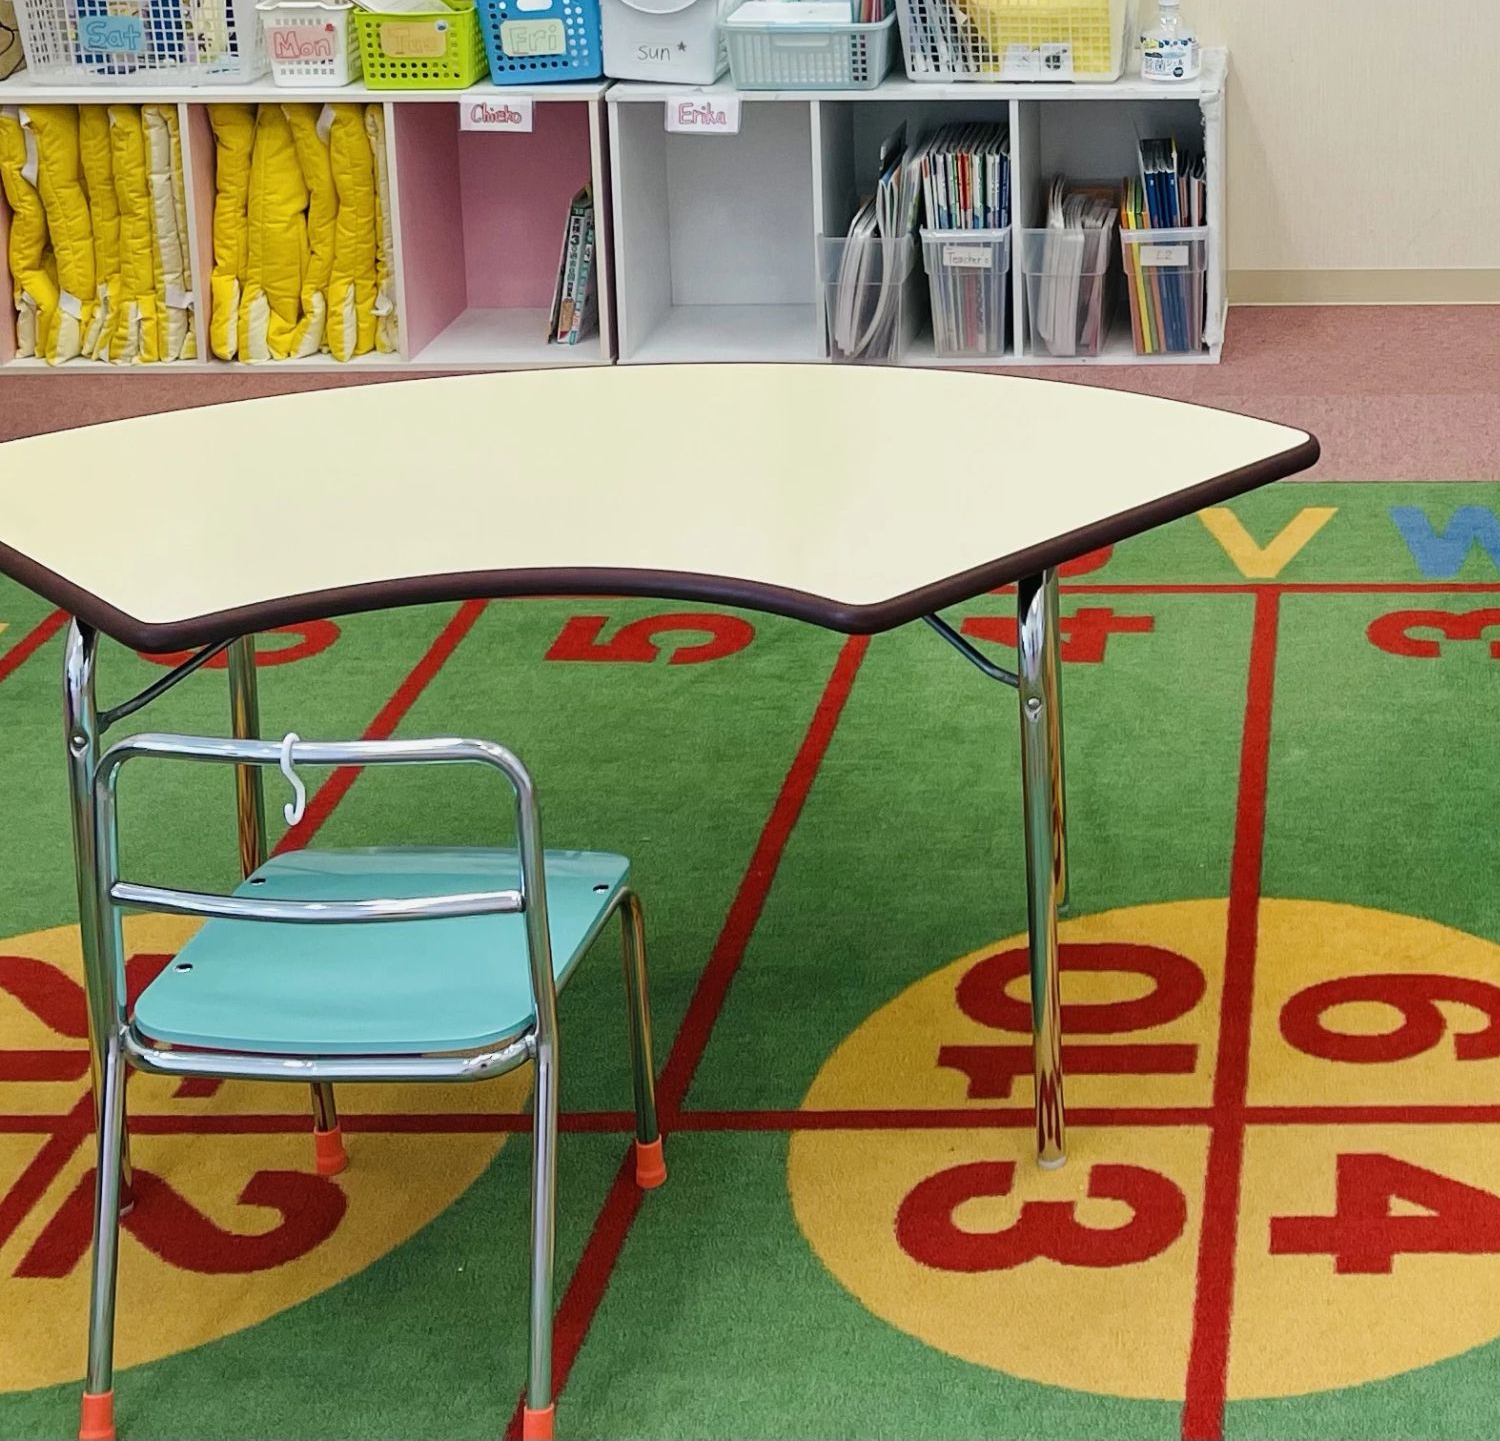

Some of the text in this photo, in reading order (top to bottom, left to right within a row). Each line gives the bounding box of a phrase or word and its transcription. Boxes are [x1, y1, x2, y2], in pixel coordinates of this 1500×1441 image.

[86, 20, 141, 50] Sat
[274, 31, 332, 59] Mon
[508, 25, 558, 54] Fri
[678, 103, 728, 126] Erika
[1197, 507, 1338, 578] V
[545, 614, 756, 665] 5
[895, 1161, 1187, 1273] 3
